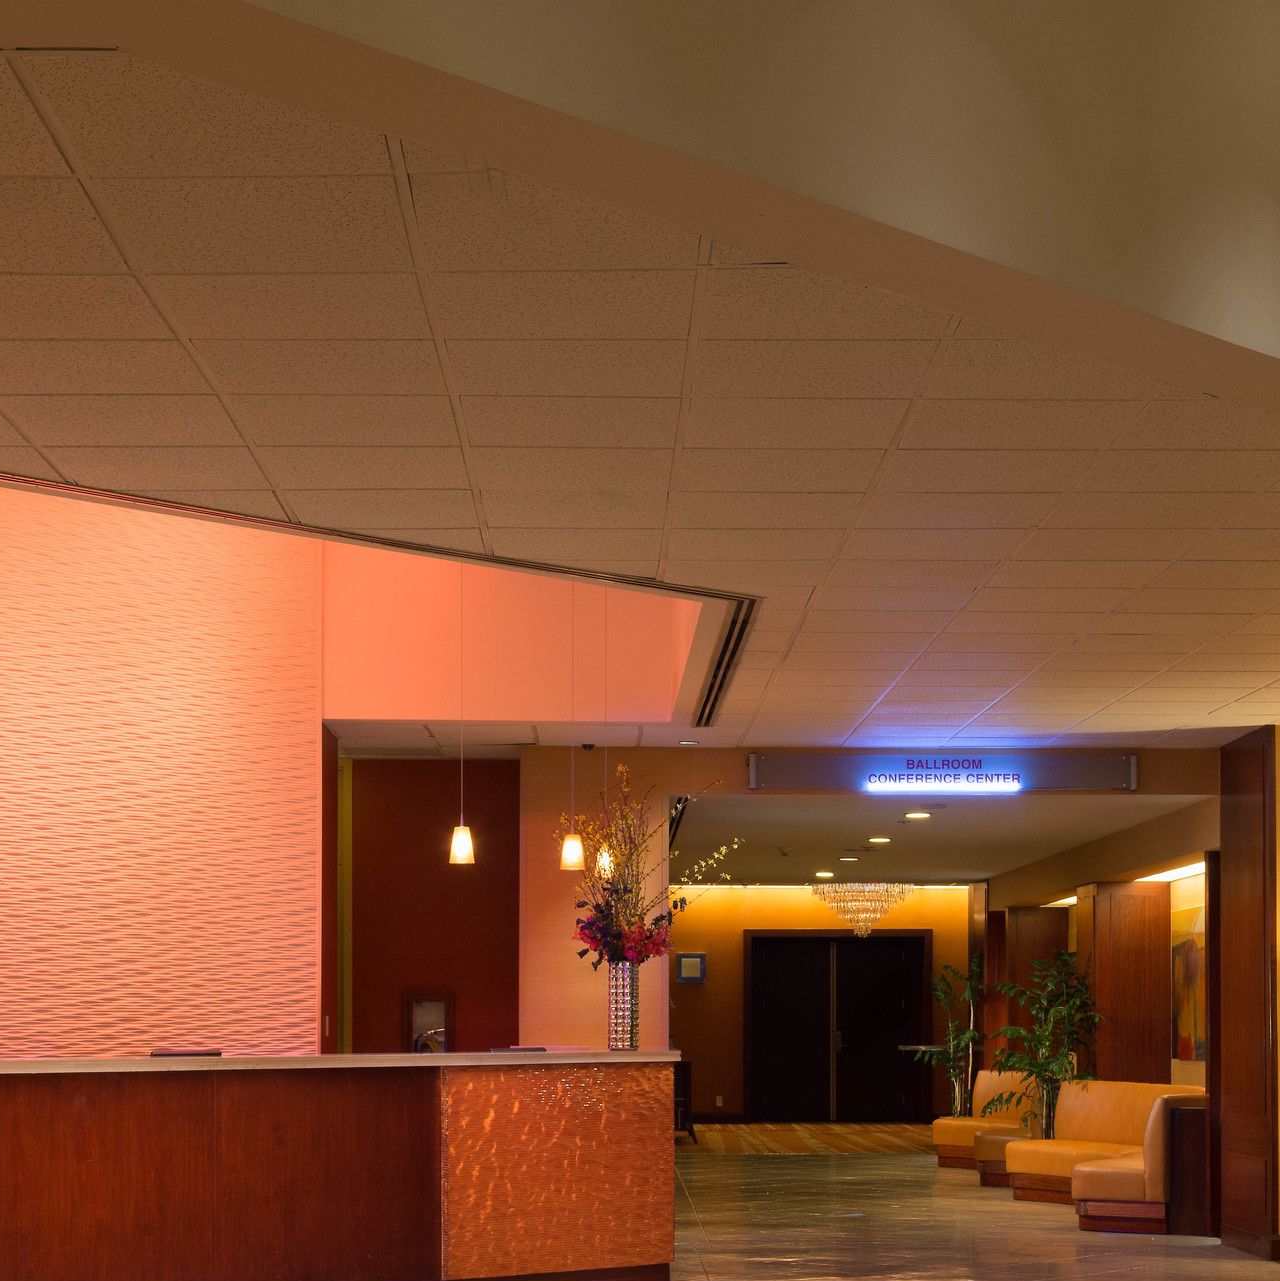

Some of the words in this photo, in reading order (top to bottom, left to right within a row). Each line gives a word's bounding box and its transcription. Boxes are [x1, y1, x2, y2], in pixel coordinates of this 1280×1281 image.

[906, 759, 982, 770] BALLROOM
[868, 773, 961, 784] CONFERENCE
[966, 773, 1020, 784] CENTER
